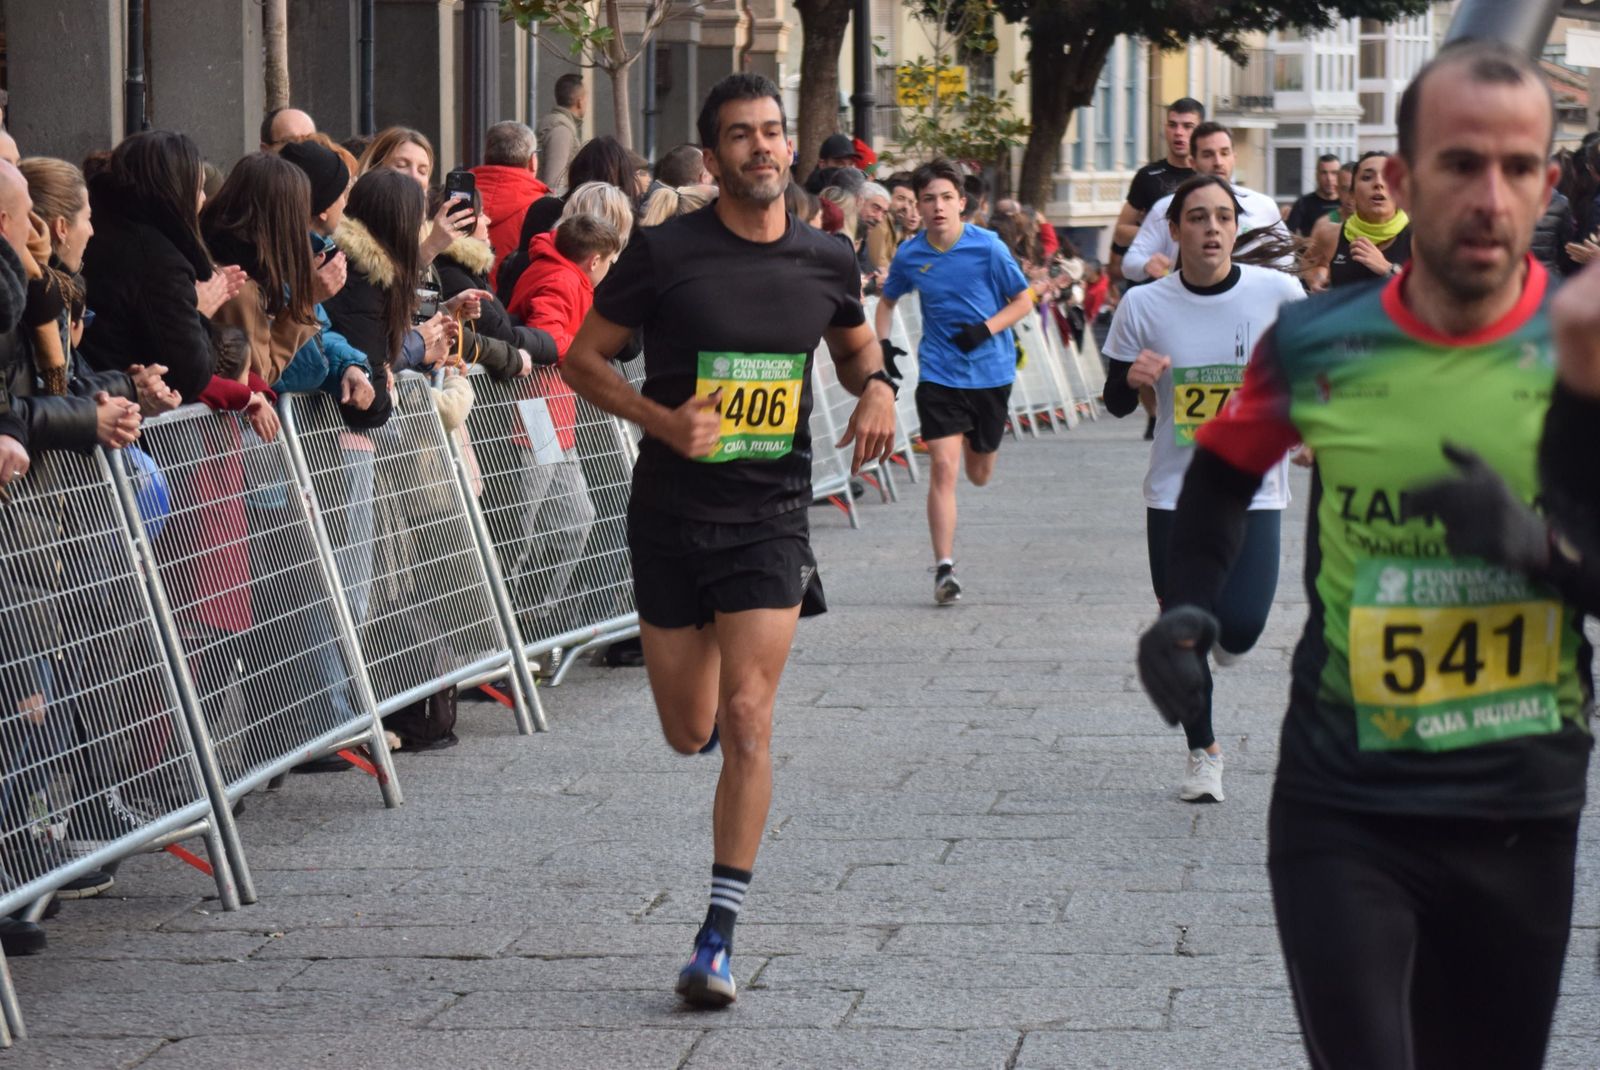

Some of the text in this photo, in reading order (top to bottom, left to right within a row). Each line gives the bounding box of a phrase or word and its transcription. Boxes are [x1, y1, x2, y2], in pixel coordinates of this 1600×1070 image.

[732, 369, 792, 380] CAJA RURAL
[1185, 387, 1242, 419] 27
[723, 439, 787, 454] CAJA RURAL
[1382, 612, 1526, 696] 541
[1415, 695, 1549, 739] CAJA RURAL
